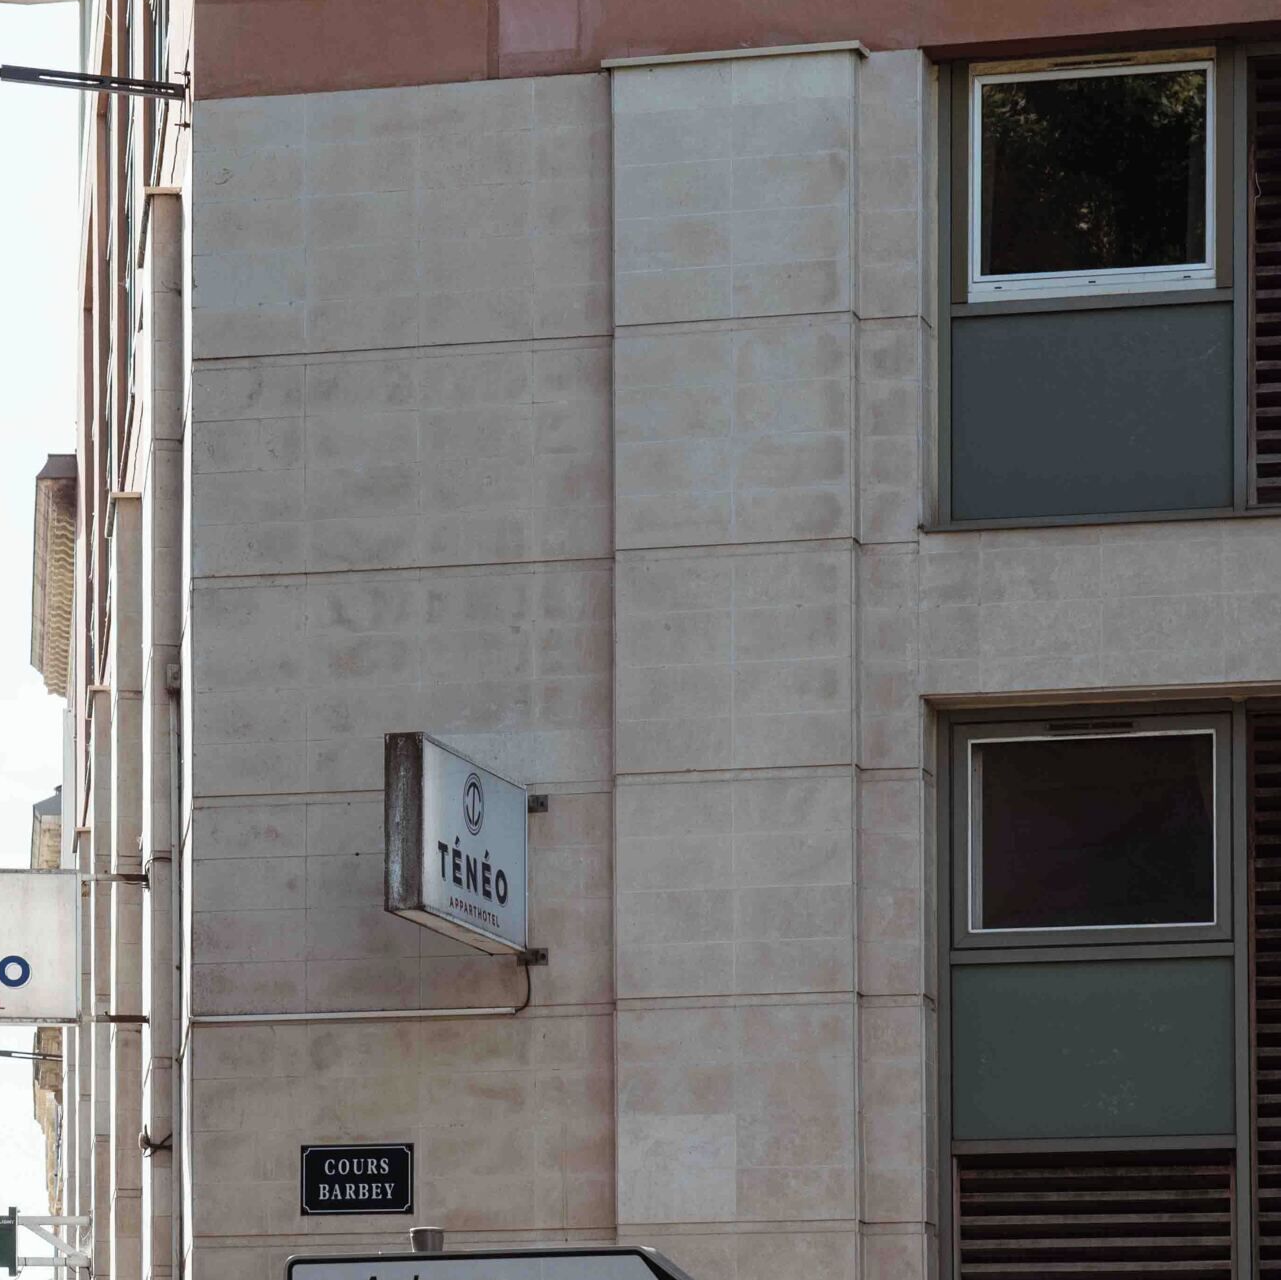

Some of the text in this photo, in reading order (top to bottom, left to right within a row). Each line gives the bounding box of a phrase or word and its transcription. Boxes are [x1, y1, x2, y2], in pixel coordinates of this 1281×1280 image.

[438, 835, 509, 907] TÉNÉO
[449, 896, 501, 928] APPARTHOTEL
[324, 1157, 390, 1176] COURS
[318, 1183, 396, 1200] BARBEY
